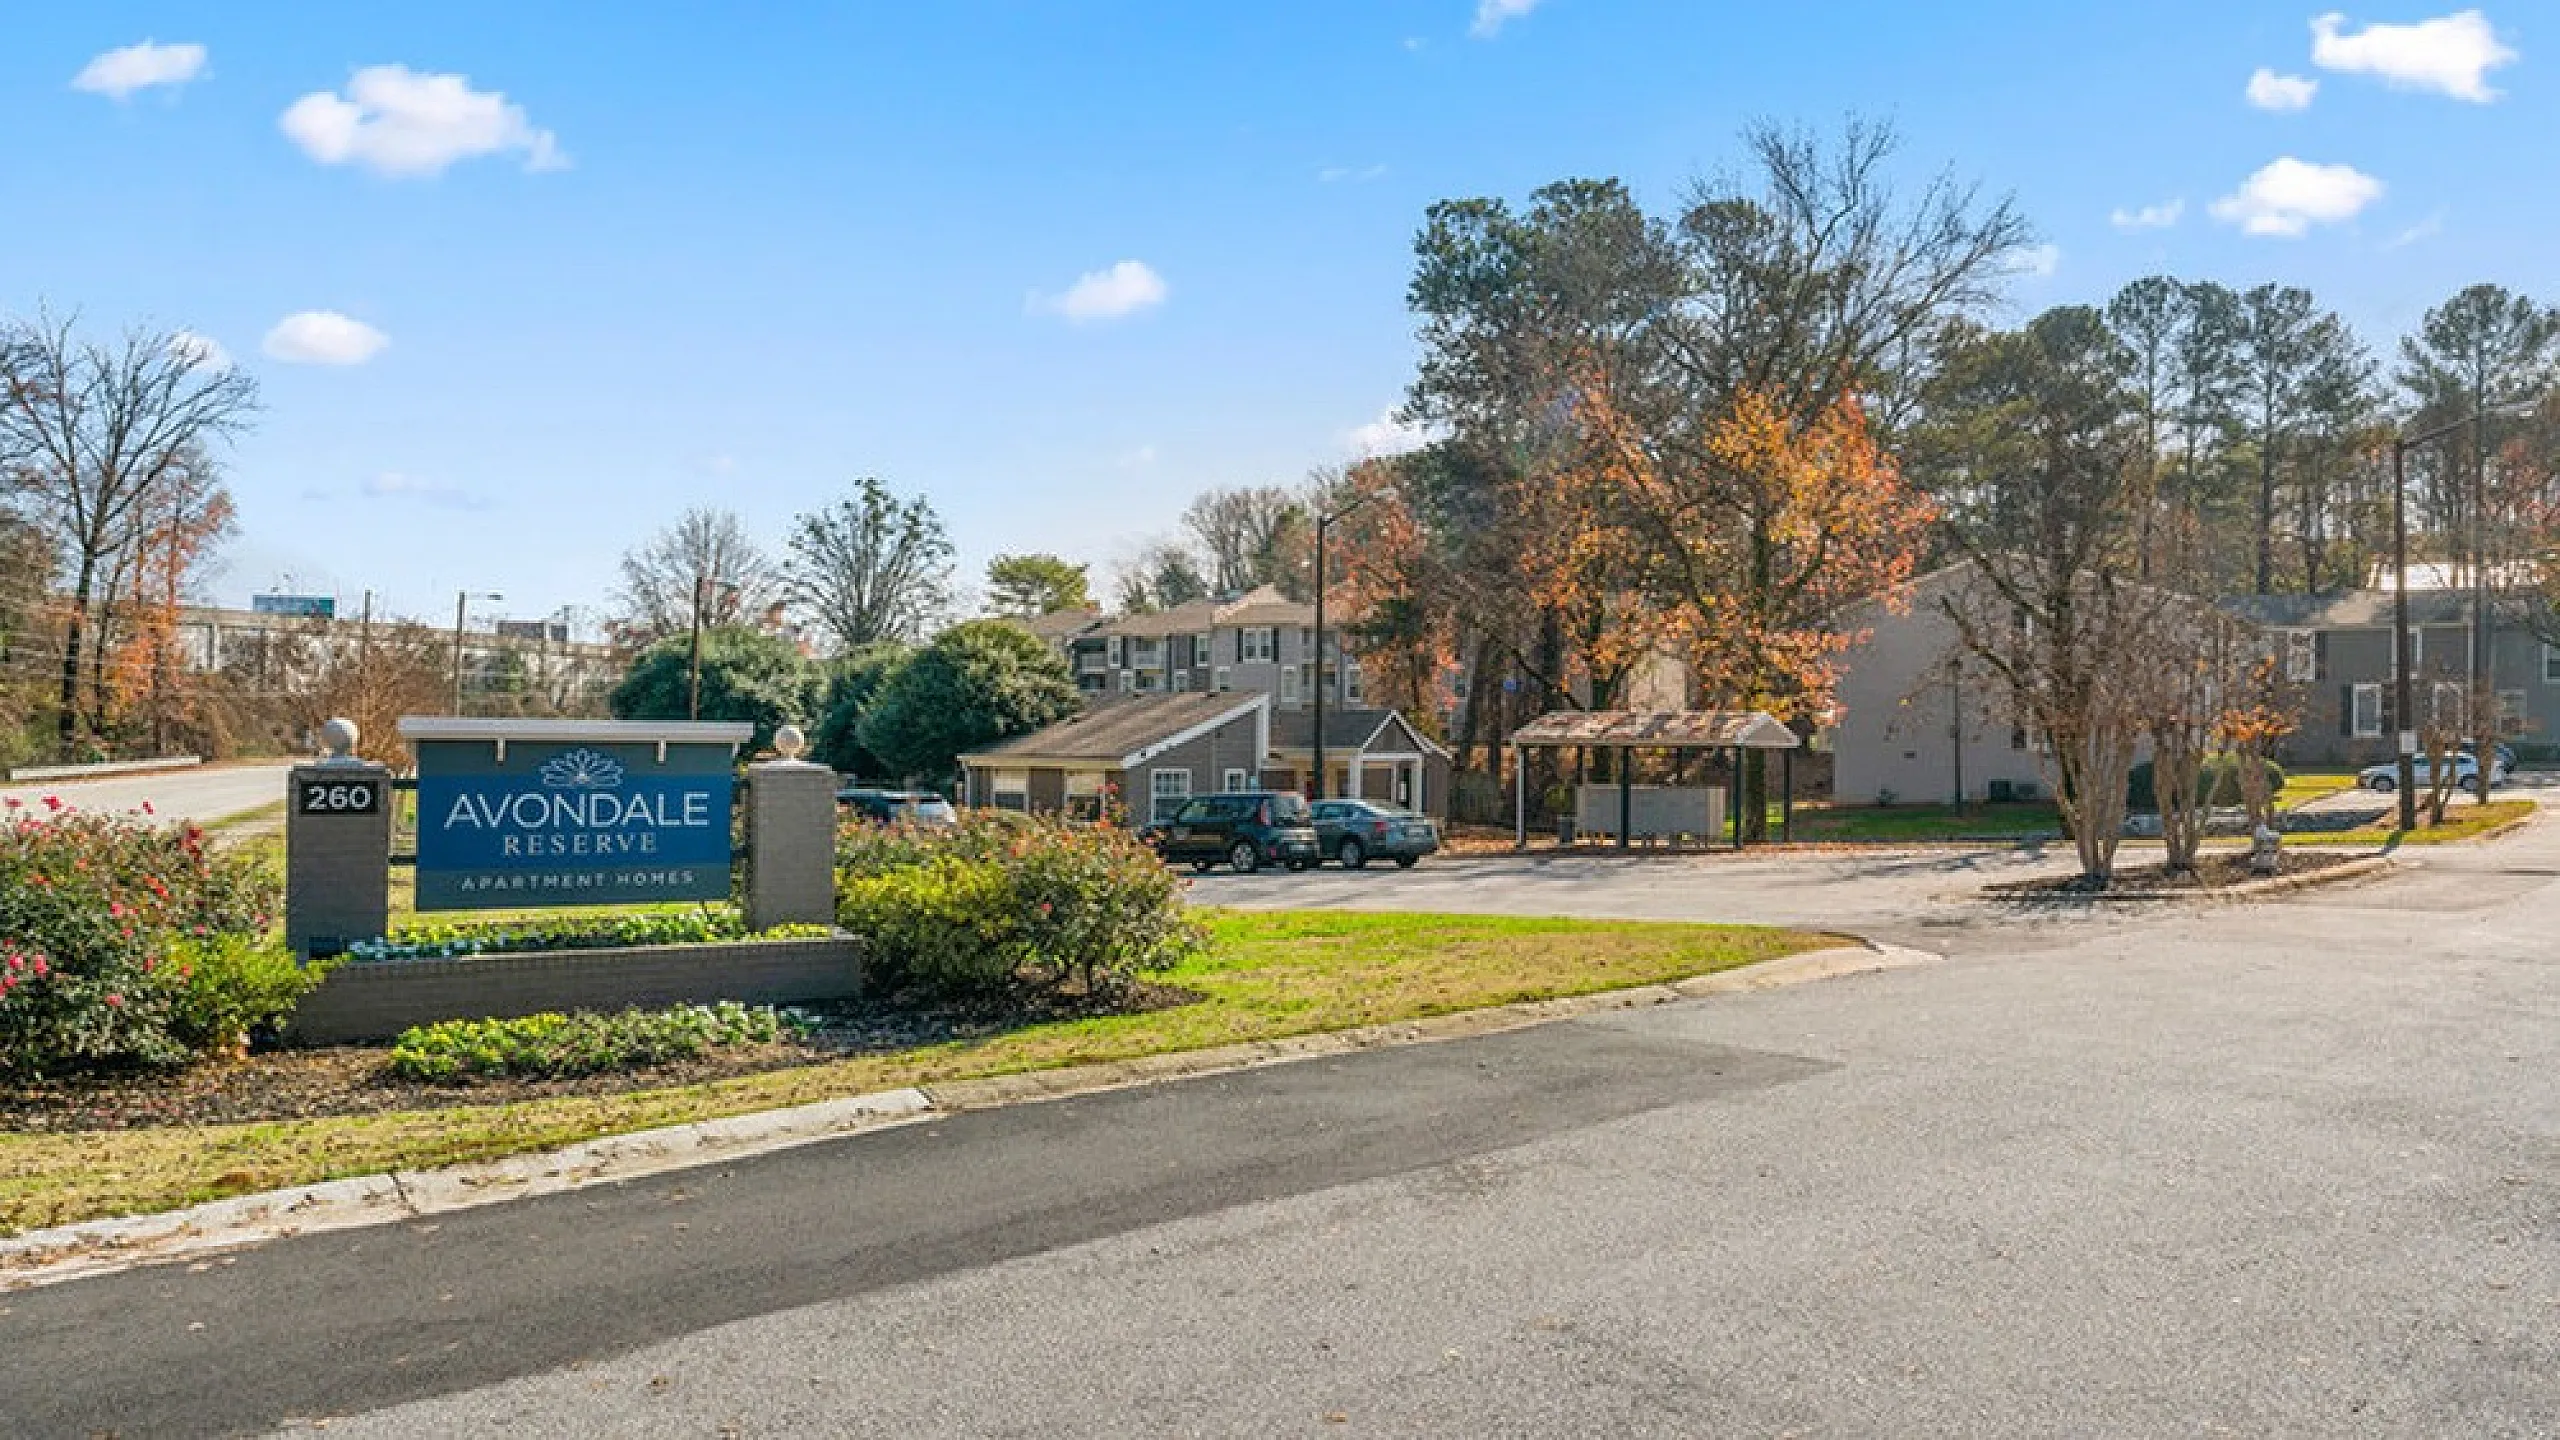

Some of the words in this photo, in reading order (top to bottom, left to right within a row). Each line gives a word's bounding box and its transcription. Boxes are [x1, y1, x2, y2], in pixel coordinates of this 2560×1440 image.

[307, 784, 372, 811] 260
[443, 792, 711, 829] AVONDALE
[503, 832, 658, 856] RESERVE
[461, 871, 604, 892] APARTMENT
[616, 869, 694, 888] HOMES
